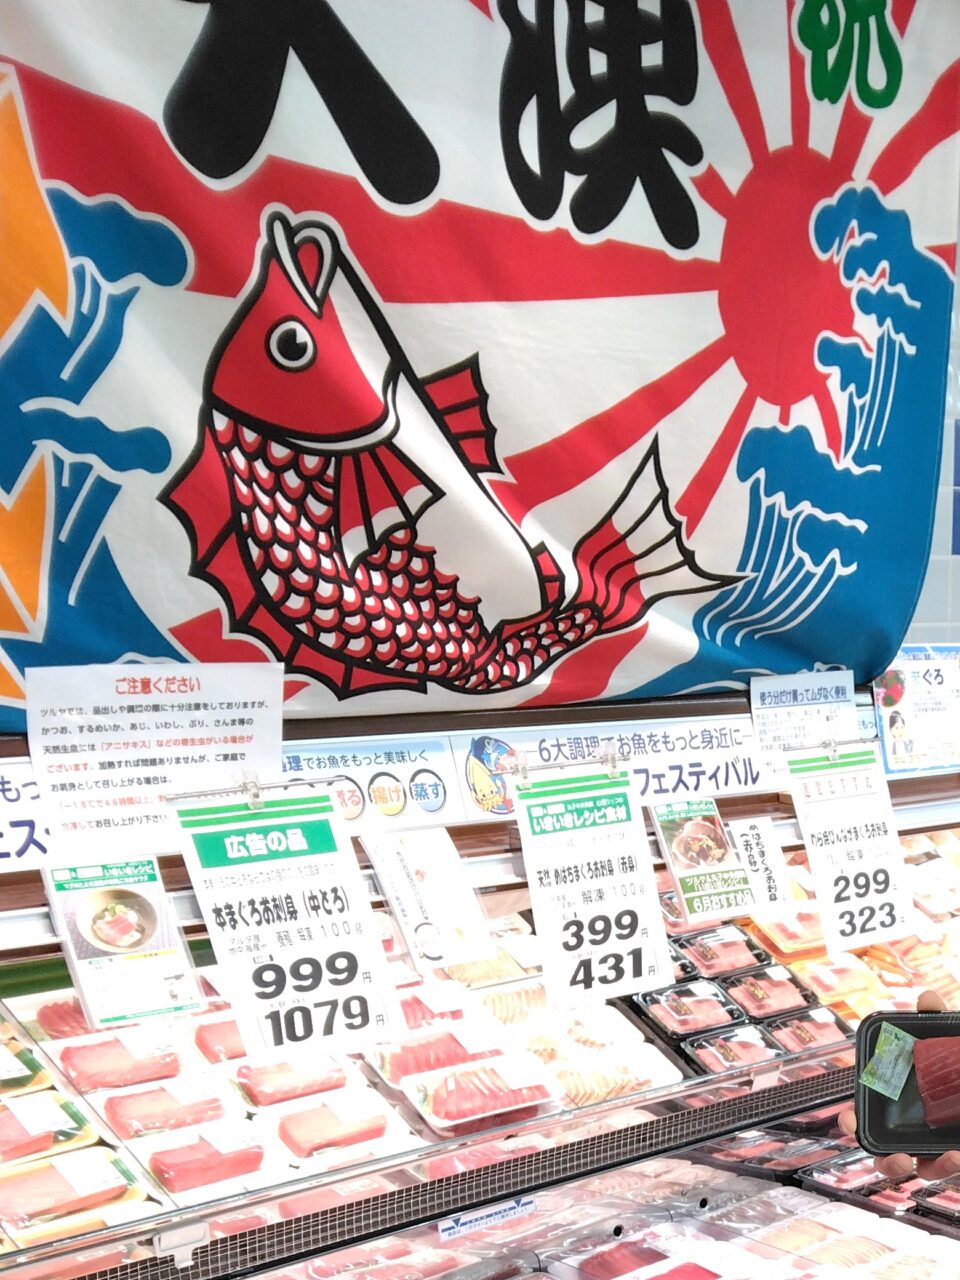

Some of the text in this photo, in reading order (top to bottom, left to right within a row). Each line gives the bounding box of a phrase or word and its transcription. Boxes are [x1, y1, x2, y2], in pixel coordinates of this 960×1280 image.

[115, 676, 201, 695] ご注意ください
[760, 686, 847, 706] 使う分だけ買ってムダなく便利
[412, 782, 442, 801] 蒸す
[633, 756, 760, 796] フェスティバル
[224, 829, 309, 858] 広告の品
[833, 868, 890, 904] 299
[212, 885, 350, 932] 本まぐろお刺身（中とろ）
[839, 902, 897, 937] 323
[562, 909, 639, 951] 399
[252, 951, 372, 1000] 999 円
[569, 947, 643, 990] 431
[264, 995, 370, 1047] 1079
